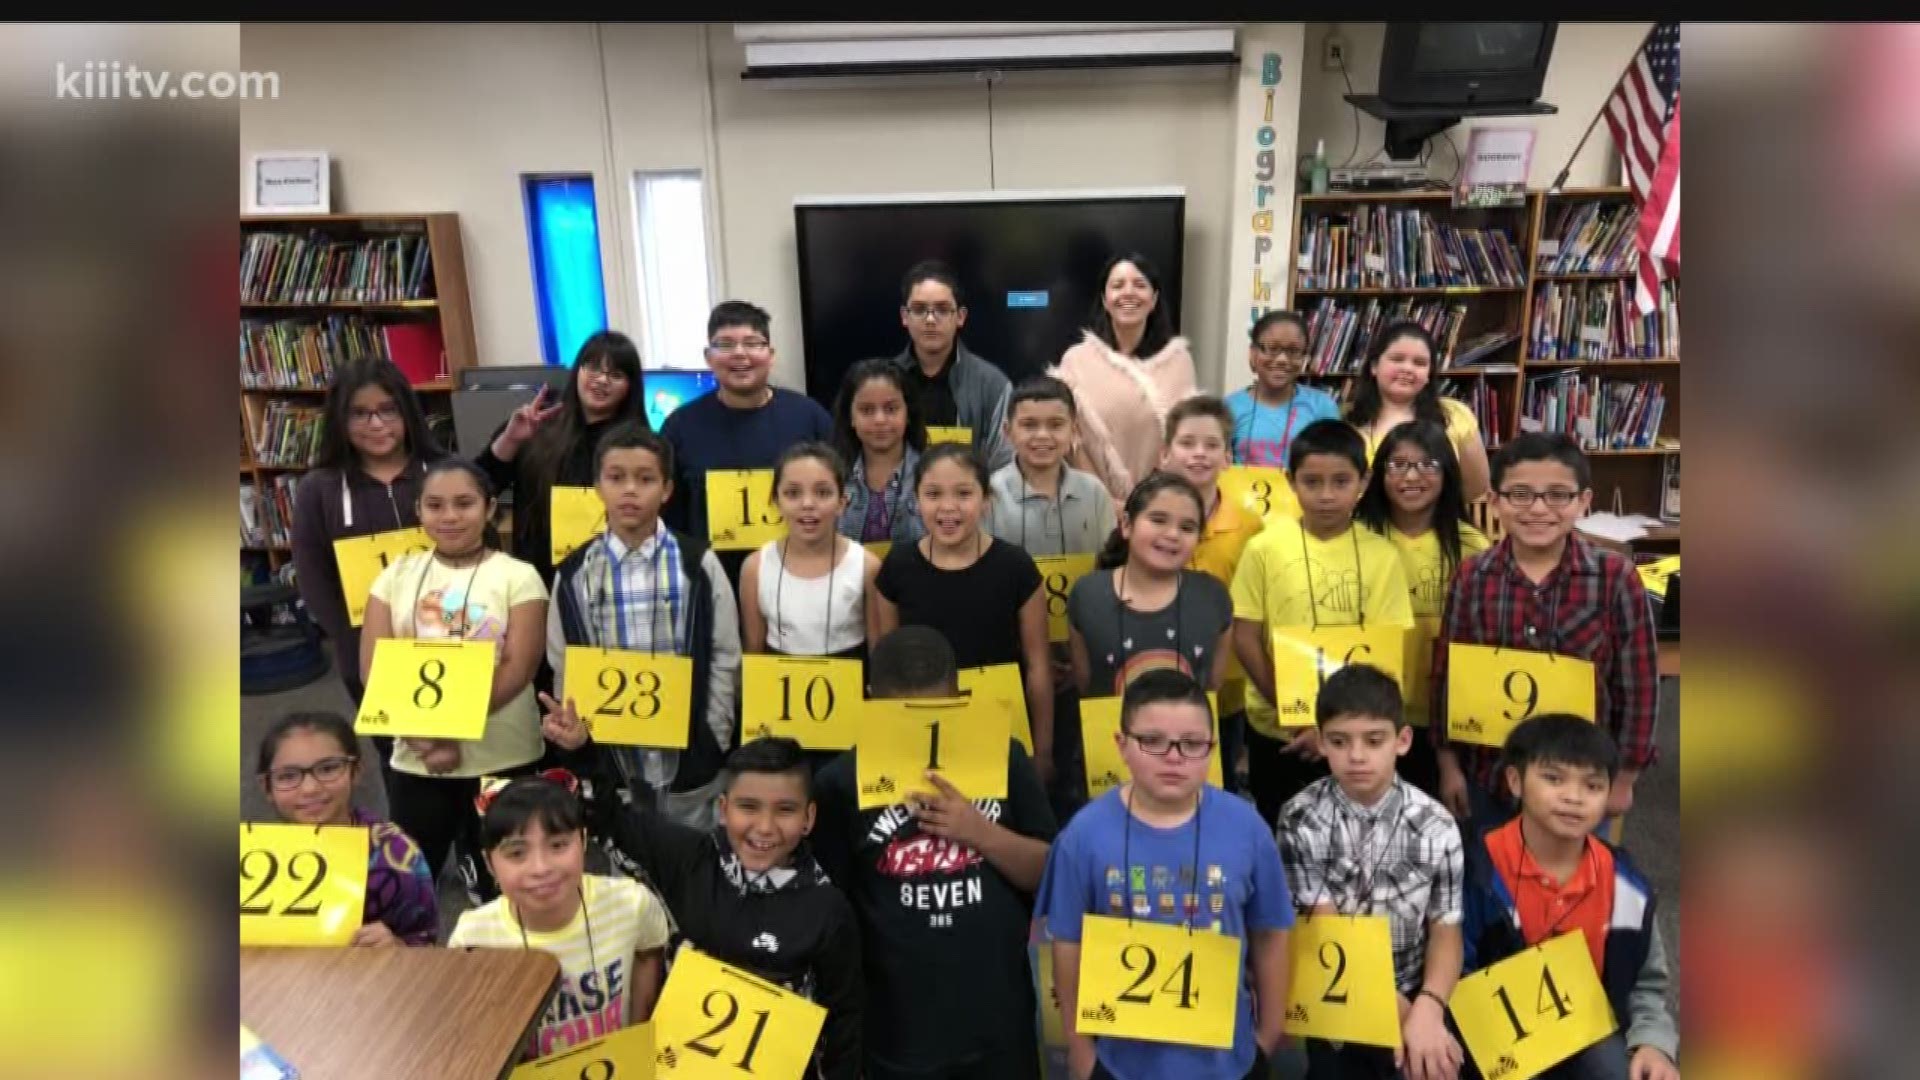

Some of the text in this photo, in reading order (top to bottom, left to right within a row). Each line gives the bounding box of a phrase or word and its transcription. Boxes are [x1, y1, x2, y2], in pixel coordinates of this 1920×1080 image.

[1251, 479, 1272, 517] 3
[412, 659, 446, 709] 8
[594, 666, 661, 719] 23
[777, 674, 835, 721] 10
[1502, 669, 1539, 721] 9
[923, 719, 945, 770] 1
[240, 850, 328, 916] 22
[1115, 943, 1200, 1009] 24
[1318, 940, 1349, 1006] 2
[1490, 963, 1575, 1045] 14
[683, 989, 771, 1073] 21
